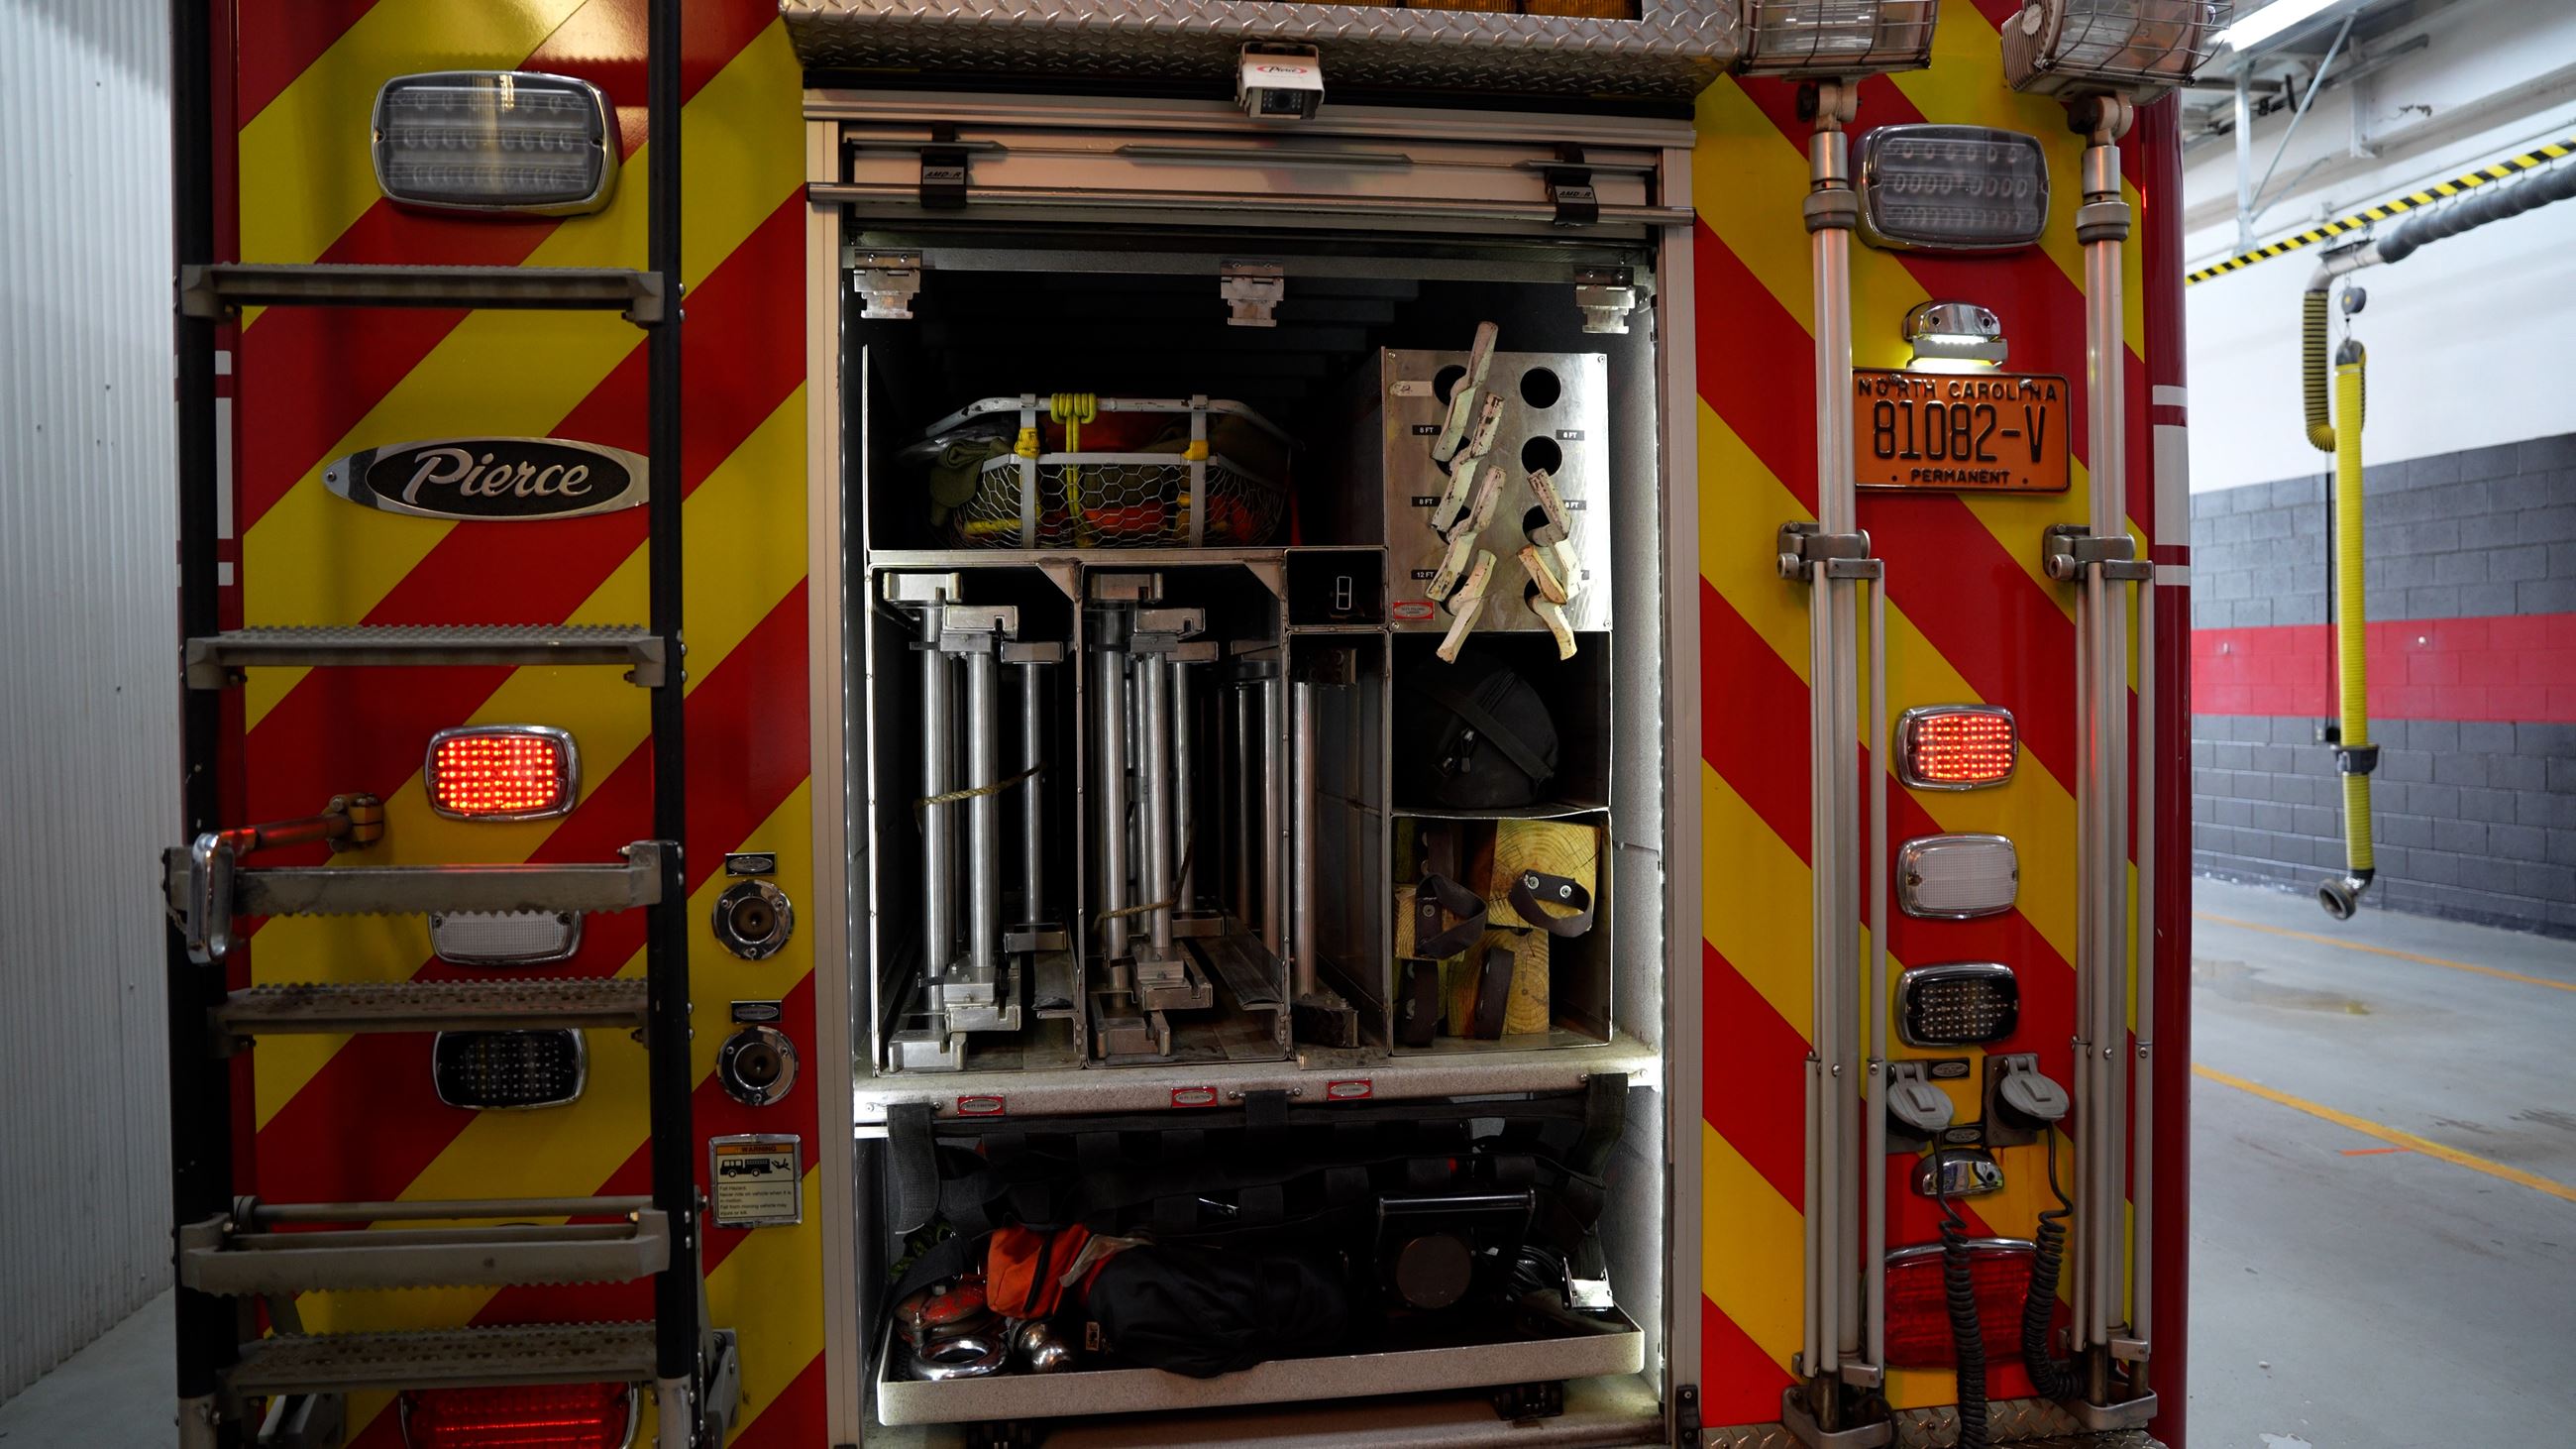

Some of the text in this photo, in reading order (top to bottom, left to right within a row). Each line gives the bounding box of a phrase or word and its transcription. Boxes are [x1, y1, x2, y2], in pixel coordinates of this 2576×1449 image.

[1859, 378, 2058, 401] NORTH CAROLINA
[1873, 399, 2046, 463] 81082-V
[402, 448, 593, 505] Pierce
[1910, 468, 2011, 485] PERMANENT
